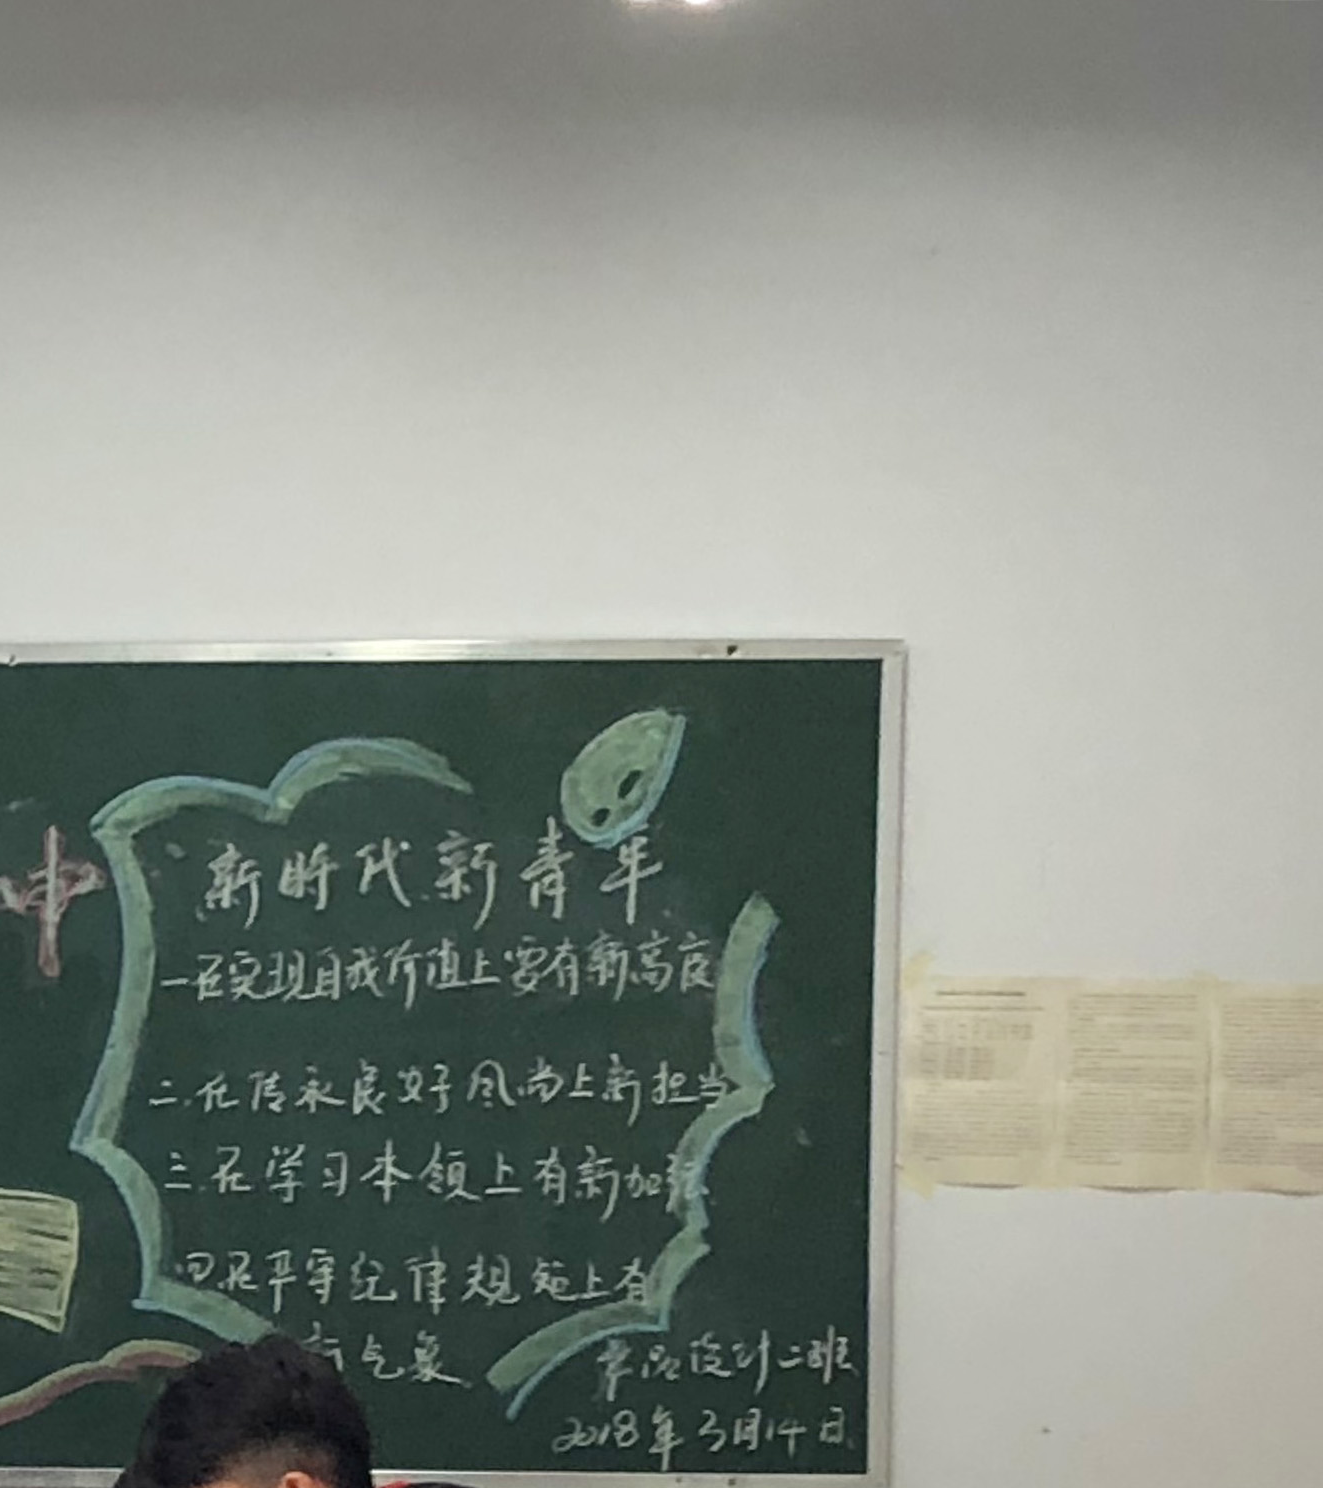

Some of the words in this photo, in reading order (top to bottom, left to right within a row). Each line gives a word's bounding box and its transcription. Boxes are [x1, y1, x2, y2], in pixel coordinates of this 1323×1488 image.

[196, 815, 663, 932] 新时代新青年
